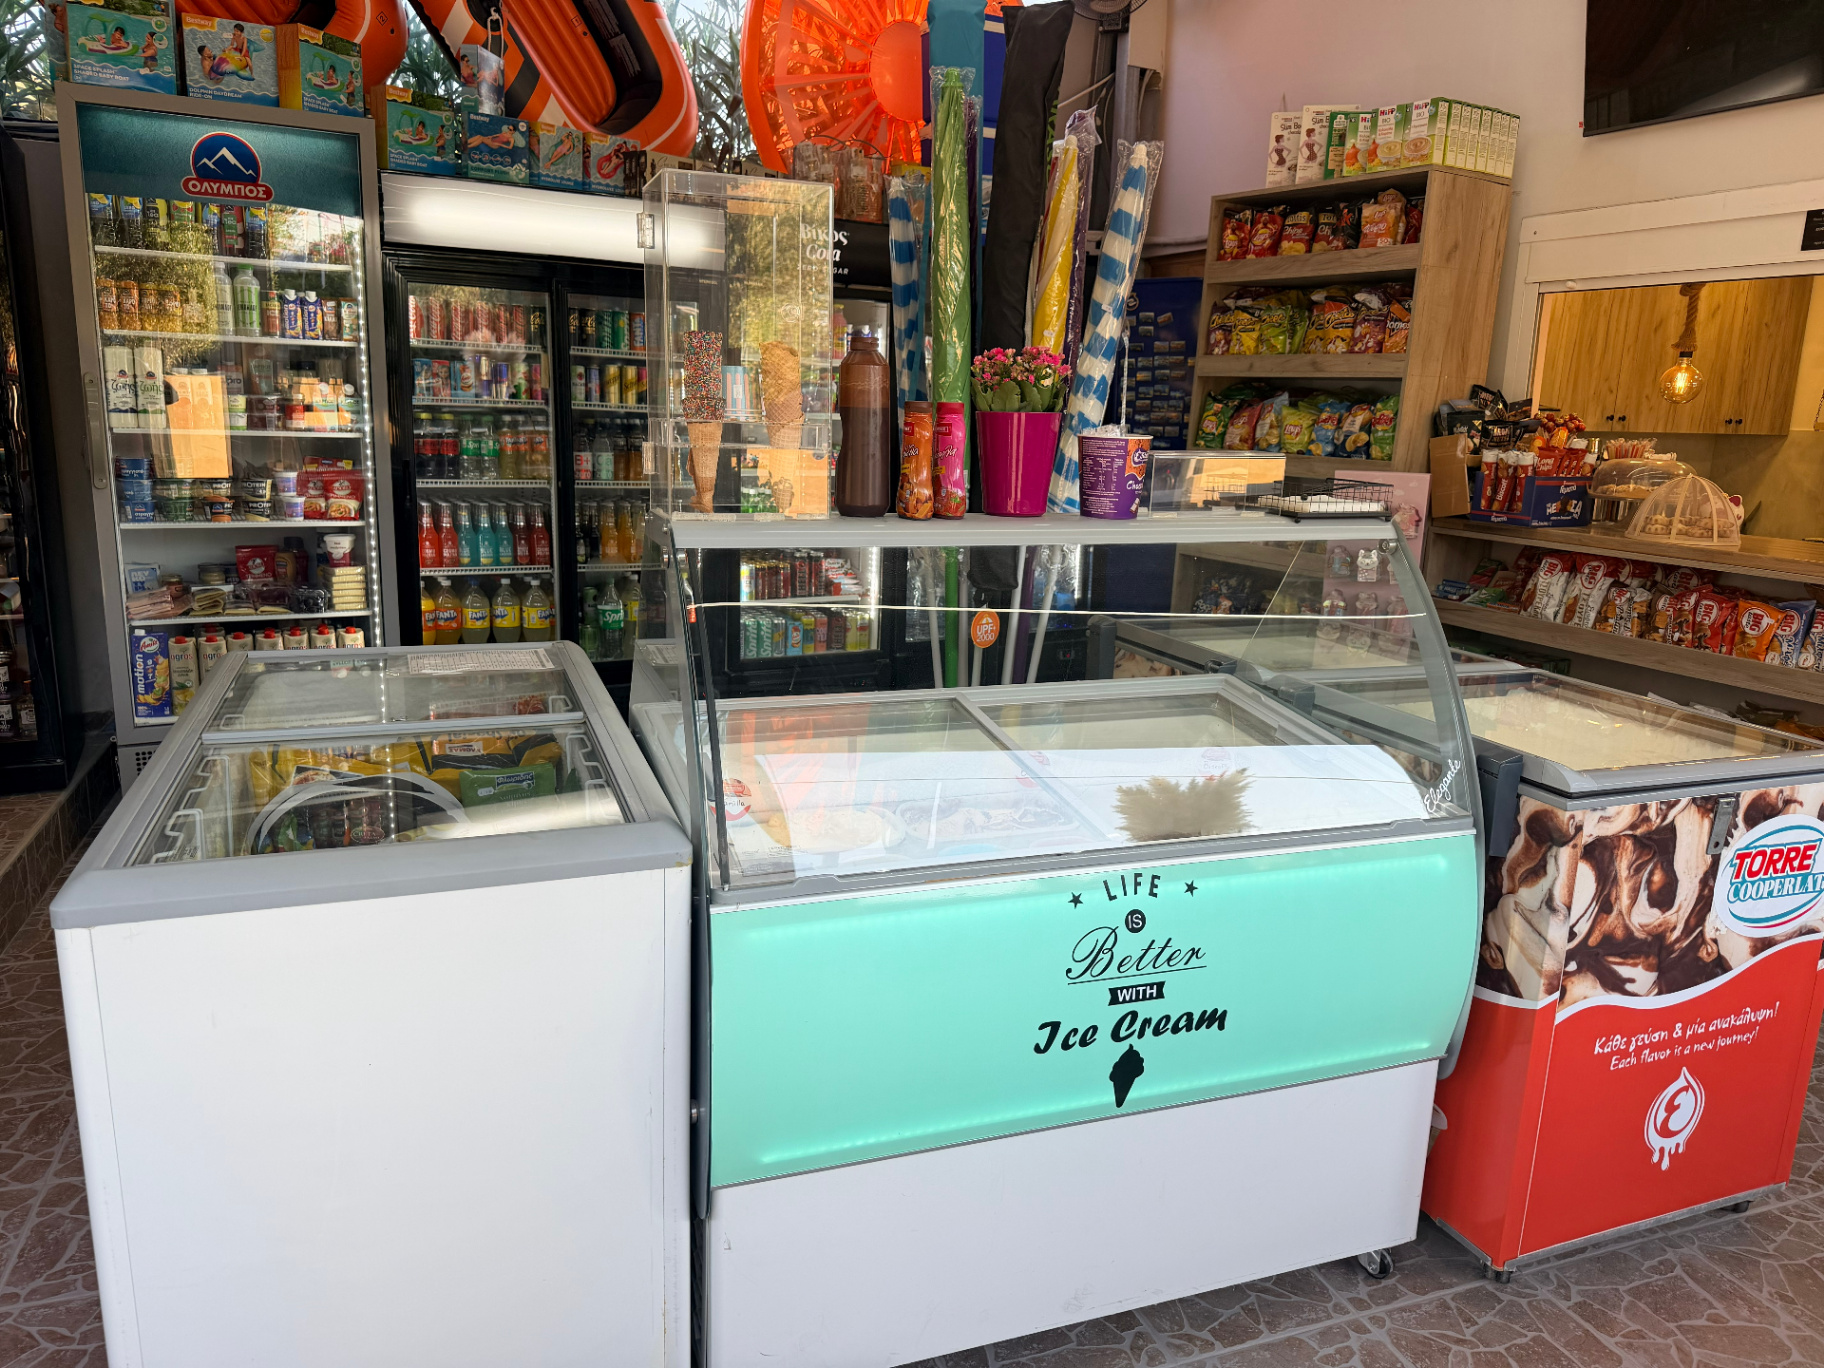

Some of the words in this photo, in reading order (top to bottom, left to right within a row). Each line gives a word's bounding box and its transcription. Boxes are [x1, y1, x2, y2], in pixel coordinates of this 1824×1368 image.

[186, 16, 212, 27] Bestway
[189, 87, 213, 95] DOLPHIN
[1379, 107, 1396, 116] HiPP
[1414, 101, 1430, 110] HiPP
[187, 180, 268, 200] ΟΛΥΜΠΟΣ
[1284, 424, 1302, 437] Lay's
[1543, 561, 1559, 577] BIG
[1587, 564, 1603, 585] BIG
[436, 610, 458, 620] FANTA
[468, 610, 489, 620] FANTA
[1701, 603, 1715, 623] BIG
[1749, 612, 1765, 632] BIG
[976, 624, 996, 635] UPF+
[1780, 614, 1796, 633] BIG
[746, 617, 758, 658] Sprite
[760, 617, 772, 658] Sprite
[976, 632, 995, 642] 2000
[170, 653, 193, 662] agros
[137, 653, 145, 694] motion
[1424, 759, 1461, 813] Elegante
[723, 799, 746, 807] anilla
[1732, 842, 1819, 881] TORRE
[1103, 873, 1161, 901] LIFE
[1128, 914, 1143, 929] IS
[1065, 925, 1207, 980] Better
[1117, 985, 1157, 1002] WITH
[1033, 1020, 1099, 1055] Ice
[1110, 1007, 1228, 1043] Cream
[1594, 1036, 1627, 1056] Κάθε
[1629, 1030, 1668, 1052] γεύση
[1673, 1022, 1683, 1039] &
[1686, 1019, 1706, 1039] μία
[1709, 1001, 1780, 1032] ανακάλυψη!
[1609, 1055, 1637, 1071] Each
[1640, 1049, 1672, 1066] flavor
[1674, 1045, 1682, 1057] is
[1684, 1045, 1691, 1055] a
[1693, 1041, 1715, 1052] new
[1716, 1026, 1759, 1052] journey!
